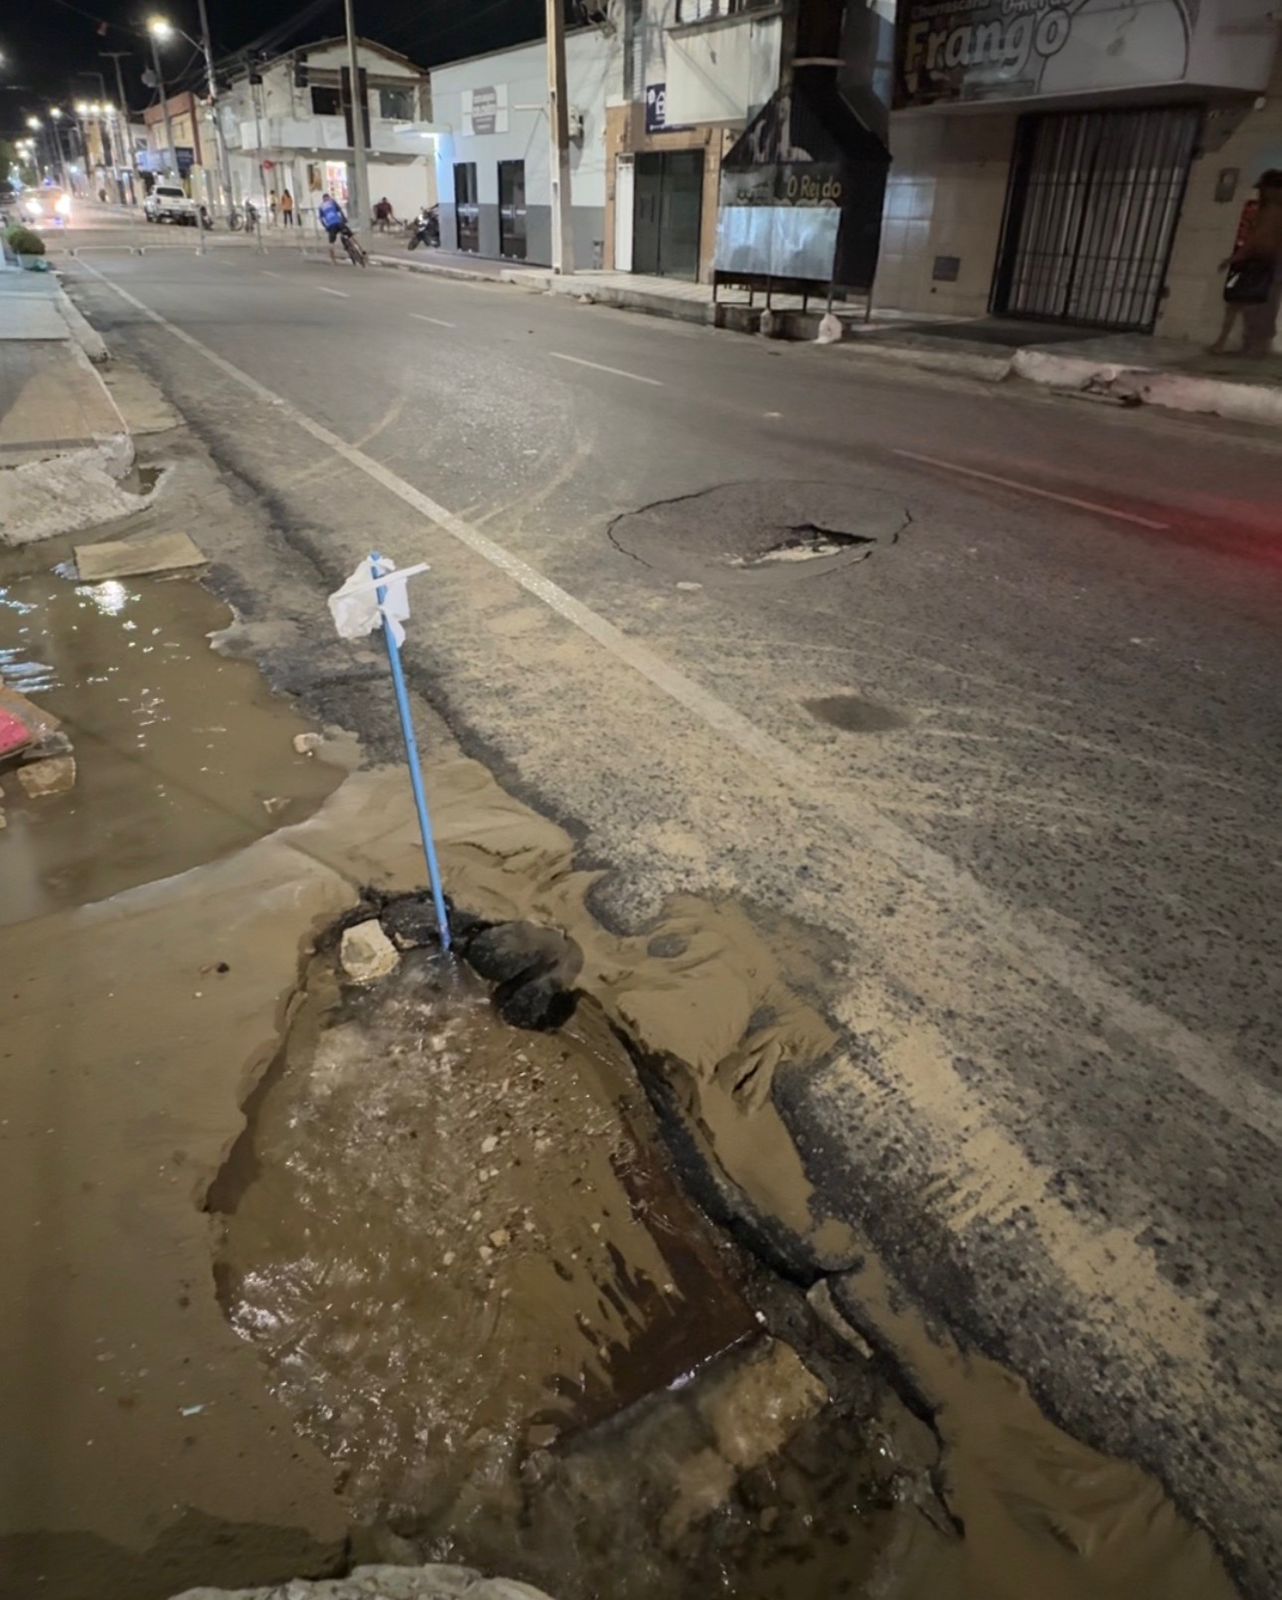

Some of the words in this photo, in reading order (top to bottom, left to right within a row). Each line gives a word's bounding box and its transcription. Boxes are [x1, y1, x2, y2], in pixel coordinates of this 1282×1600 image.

[905, 9, 1070, 79] Frango
[788, 175, 798, 198] O
[801, 174, 819, 198] Rei
[823, 175, 842, 198] do
